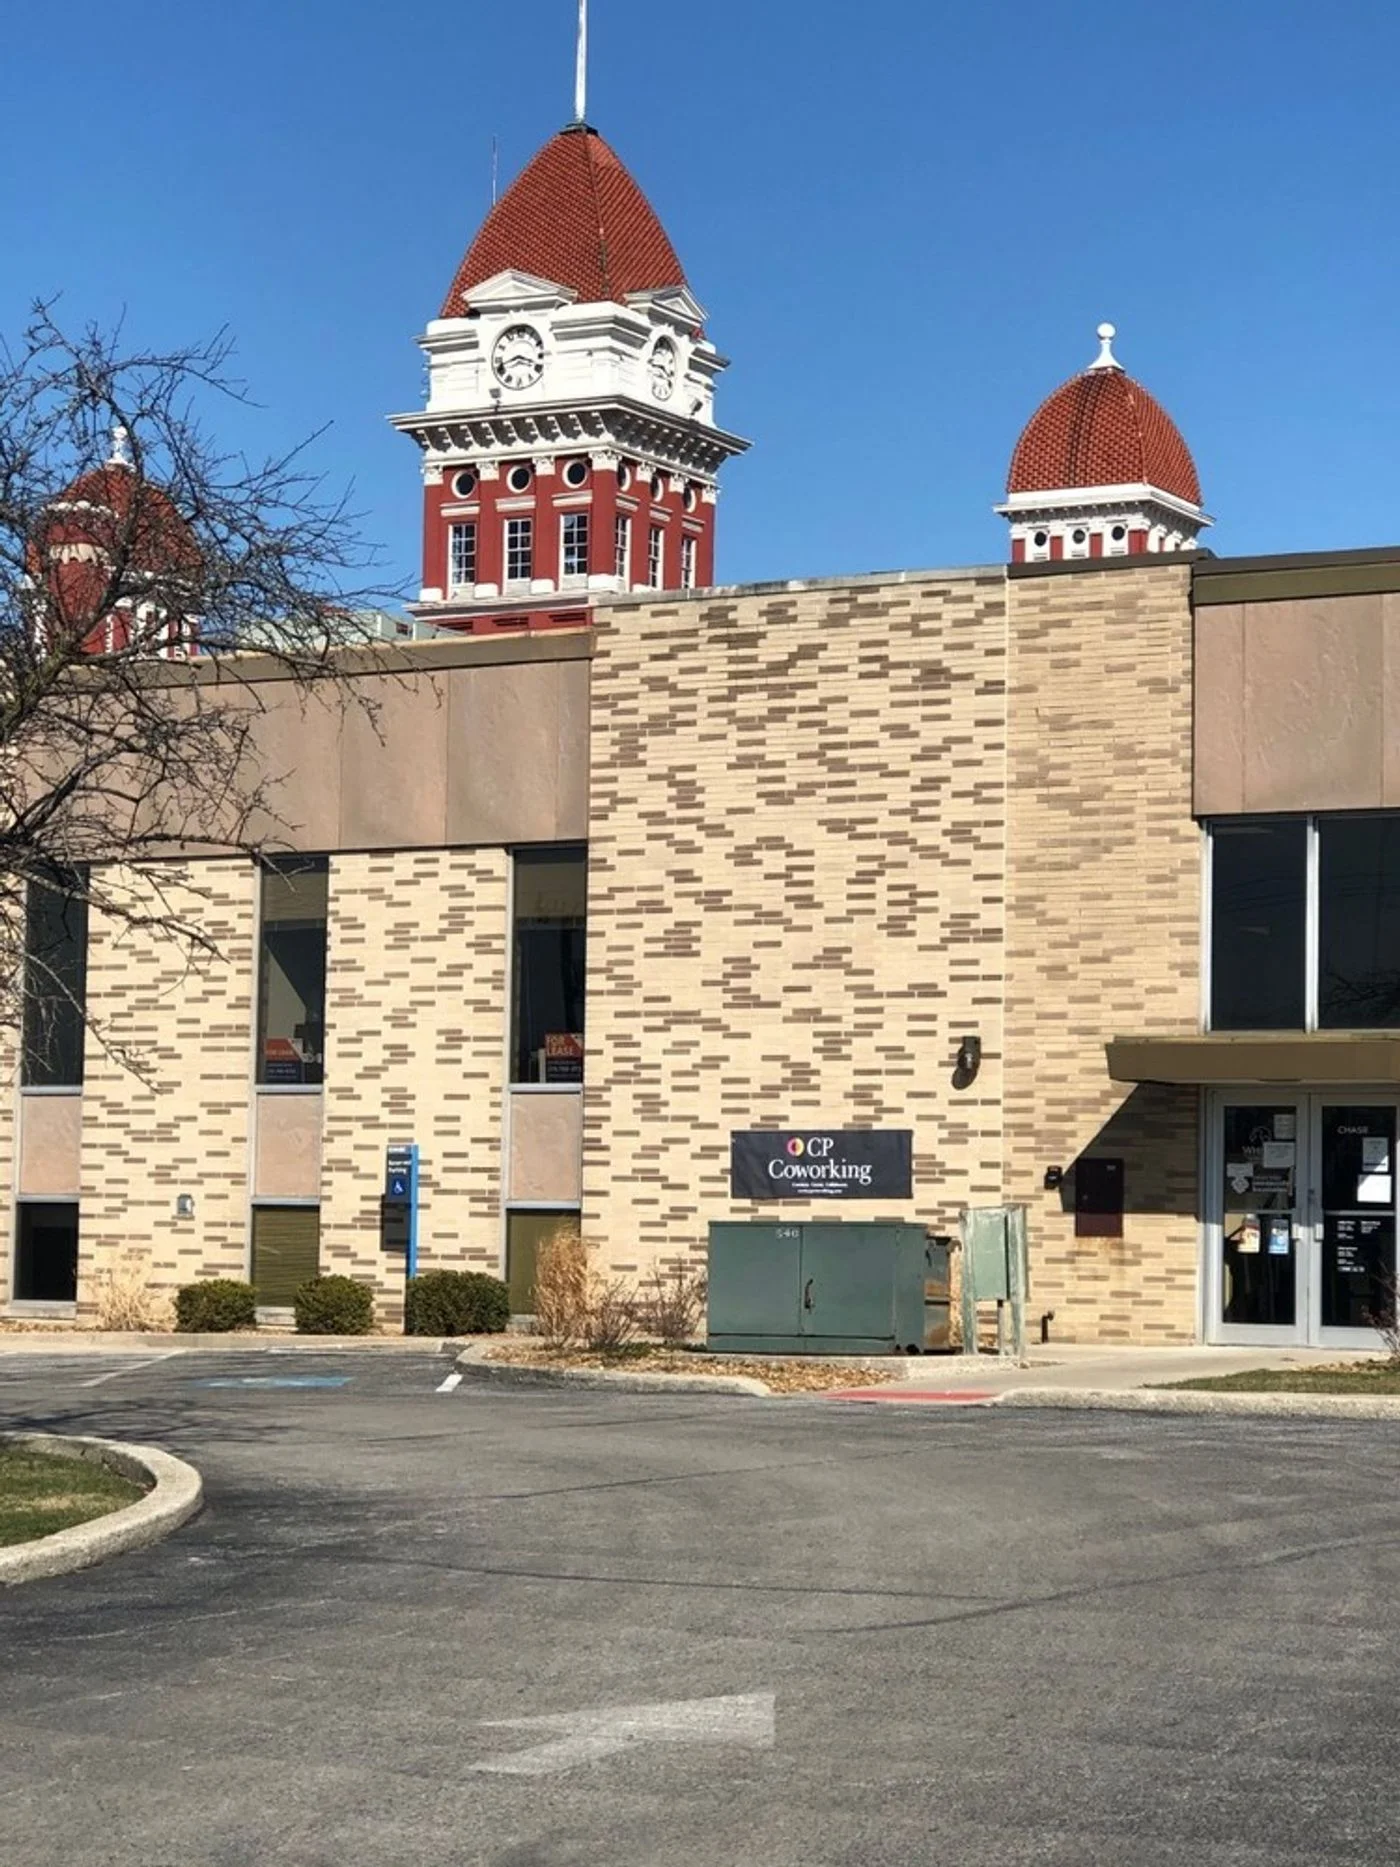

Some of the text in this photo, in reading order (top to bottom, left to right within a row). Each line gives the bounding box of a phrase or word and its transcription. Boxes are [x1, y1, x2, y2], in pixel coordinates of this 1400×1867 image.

[1337, 1126, 1369, 1134] CHASE
[806, 1137, 834, 1157] CP
[768, 1158, 873, 1185] Coworking
